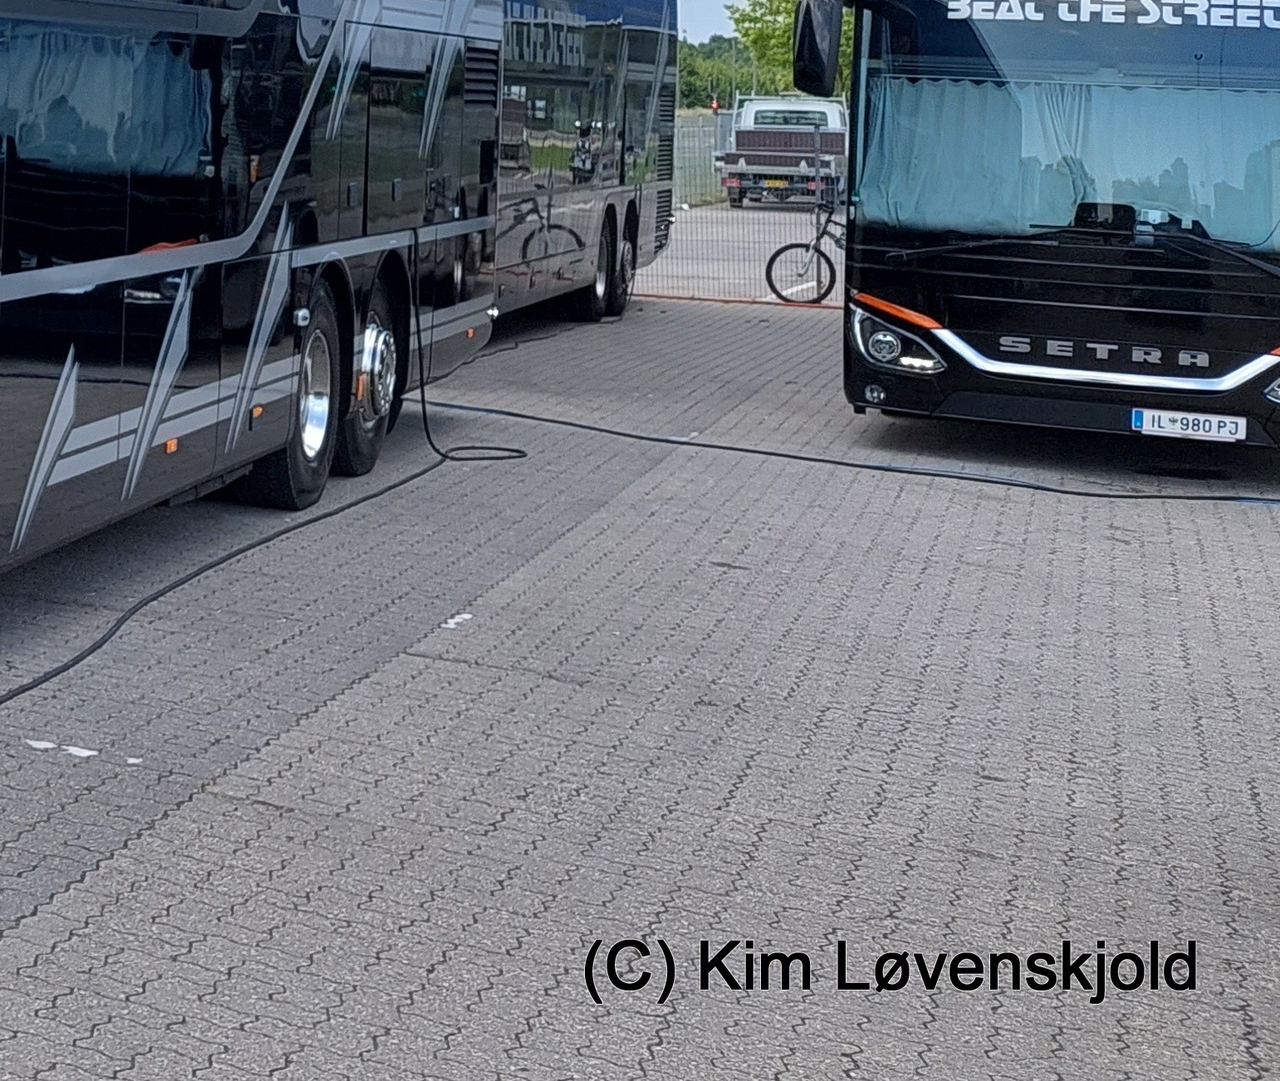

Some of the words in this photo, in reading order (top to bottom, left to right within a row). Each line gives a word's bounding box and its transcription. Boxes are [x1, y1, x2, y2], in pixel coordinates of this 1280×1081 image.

[999, 336, 1210, 368] SETRA
[1179, 416, 1213, 433] 980
[1217, 420, 1239, 435] PJ
